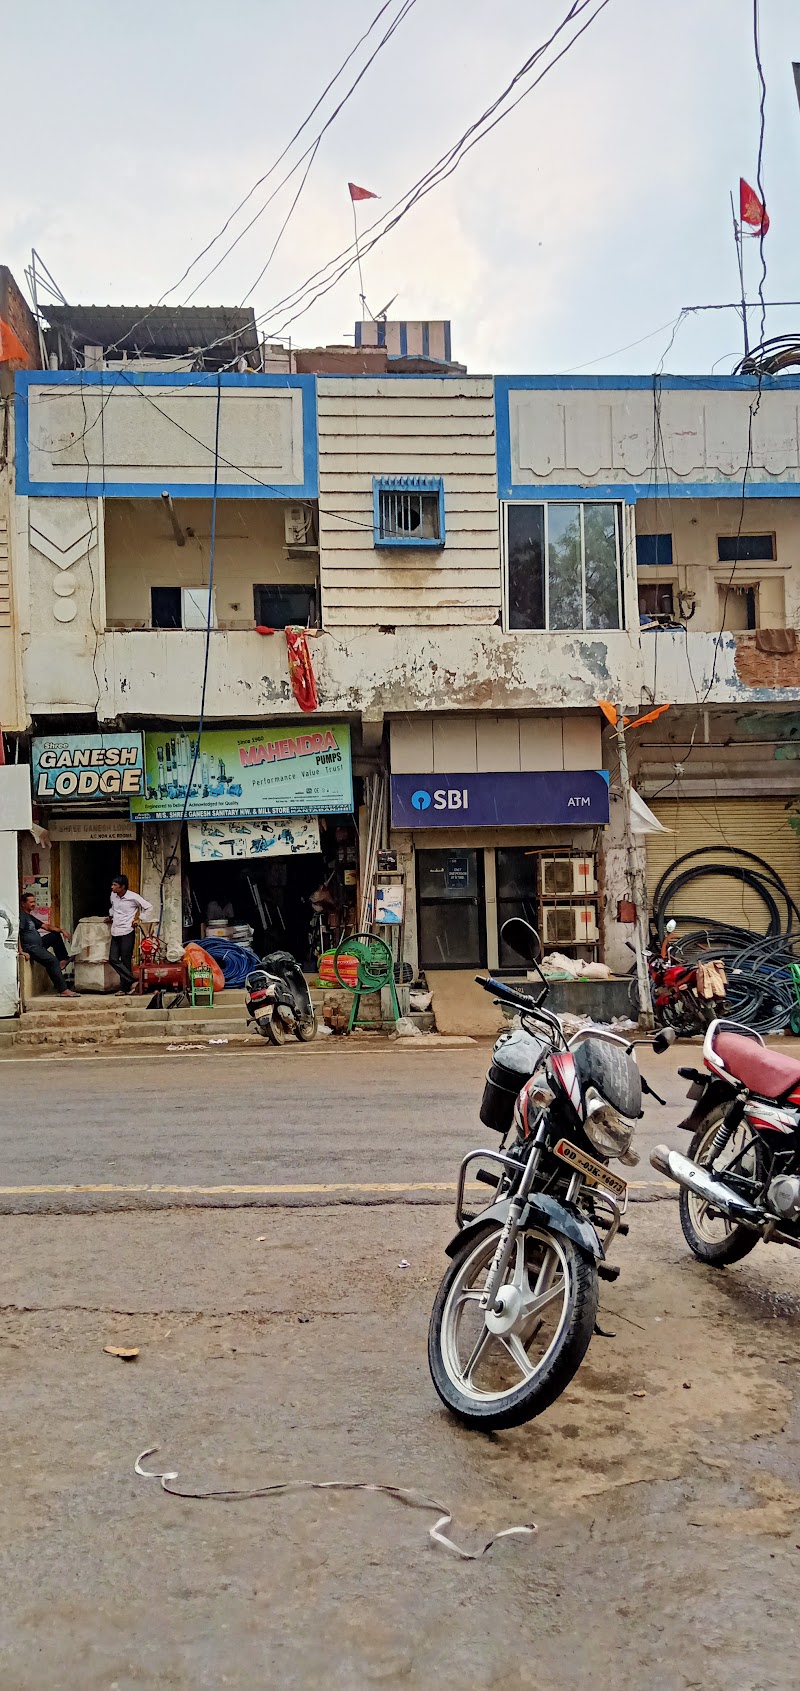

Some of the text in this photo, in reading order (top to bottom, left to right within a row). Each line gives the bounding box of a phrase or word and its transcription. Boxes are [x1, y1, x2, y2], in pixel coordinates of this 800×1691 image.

[44, 742, 69, 750] Shree
[239, 731, 339, 768] MAHENDRA
[39, 747, 138, 769] GANESH
[315, 752, 342, 766] PUMPS
[37, 769, 142, 797] LODGE
[252, 764, 344, 787] Performance Value Trust
[433, 789, 469, 810] SBI
[567, 797, 591, 807] ATM
[188, 810, 211, 818] GANESH
[211, 809, 238, 817] SANITARY
[272, 806, 290, 814] STORE
[83, 824, 112, 832] GANESH
